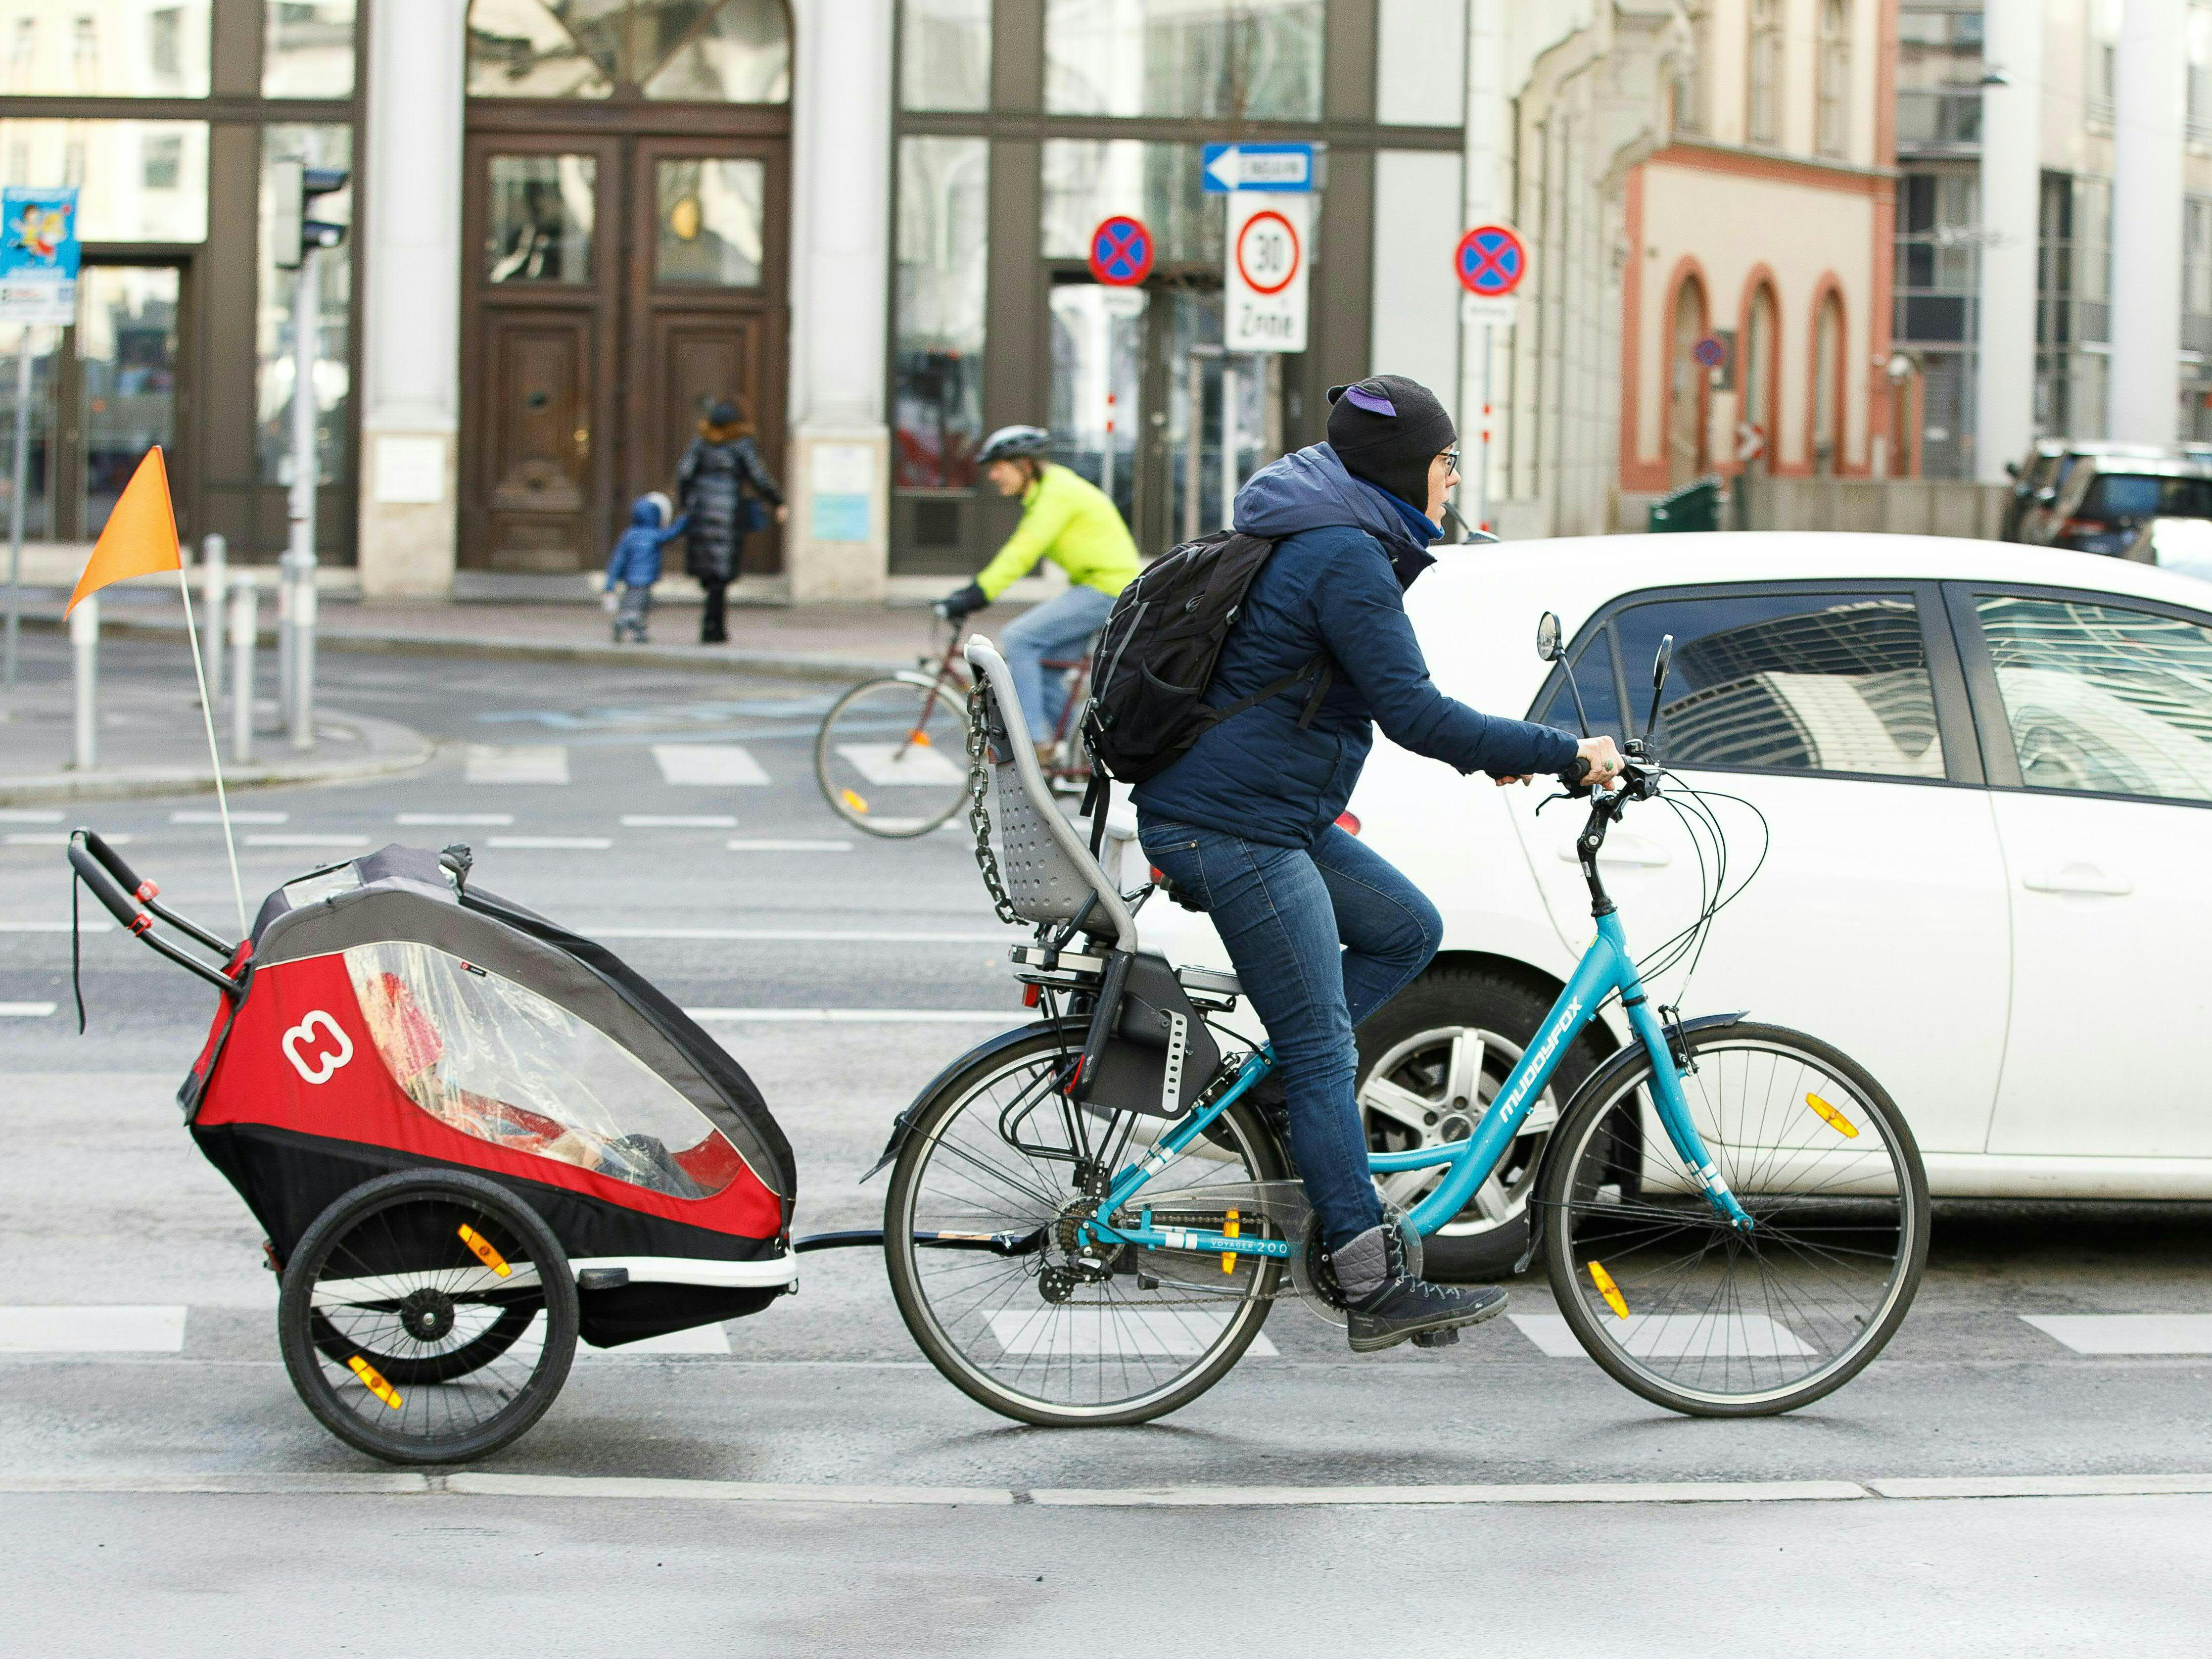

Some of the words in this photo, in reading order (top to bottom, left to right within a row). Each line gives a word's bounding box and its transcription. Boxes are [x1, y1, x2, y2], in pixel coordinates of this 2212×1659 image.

[1255, 233, 1285, 273] 30
[1212, 1240, 1253, 1249] VOYAGER
[1257, 1241, 1287, 1254] 200
